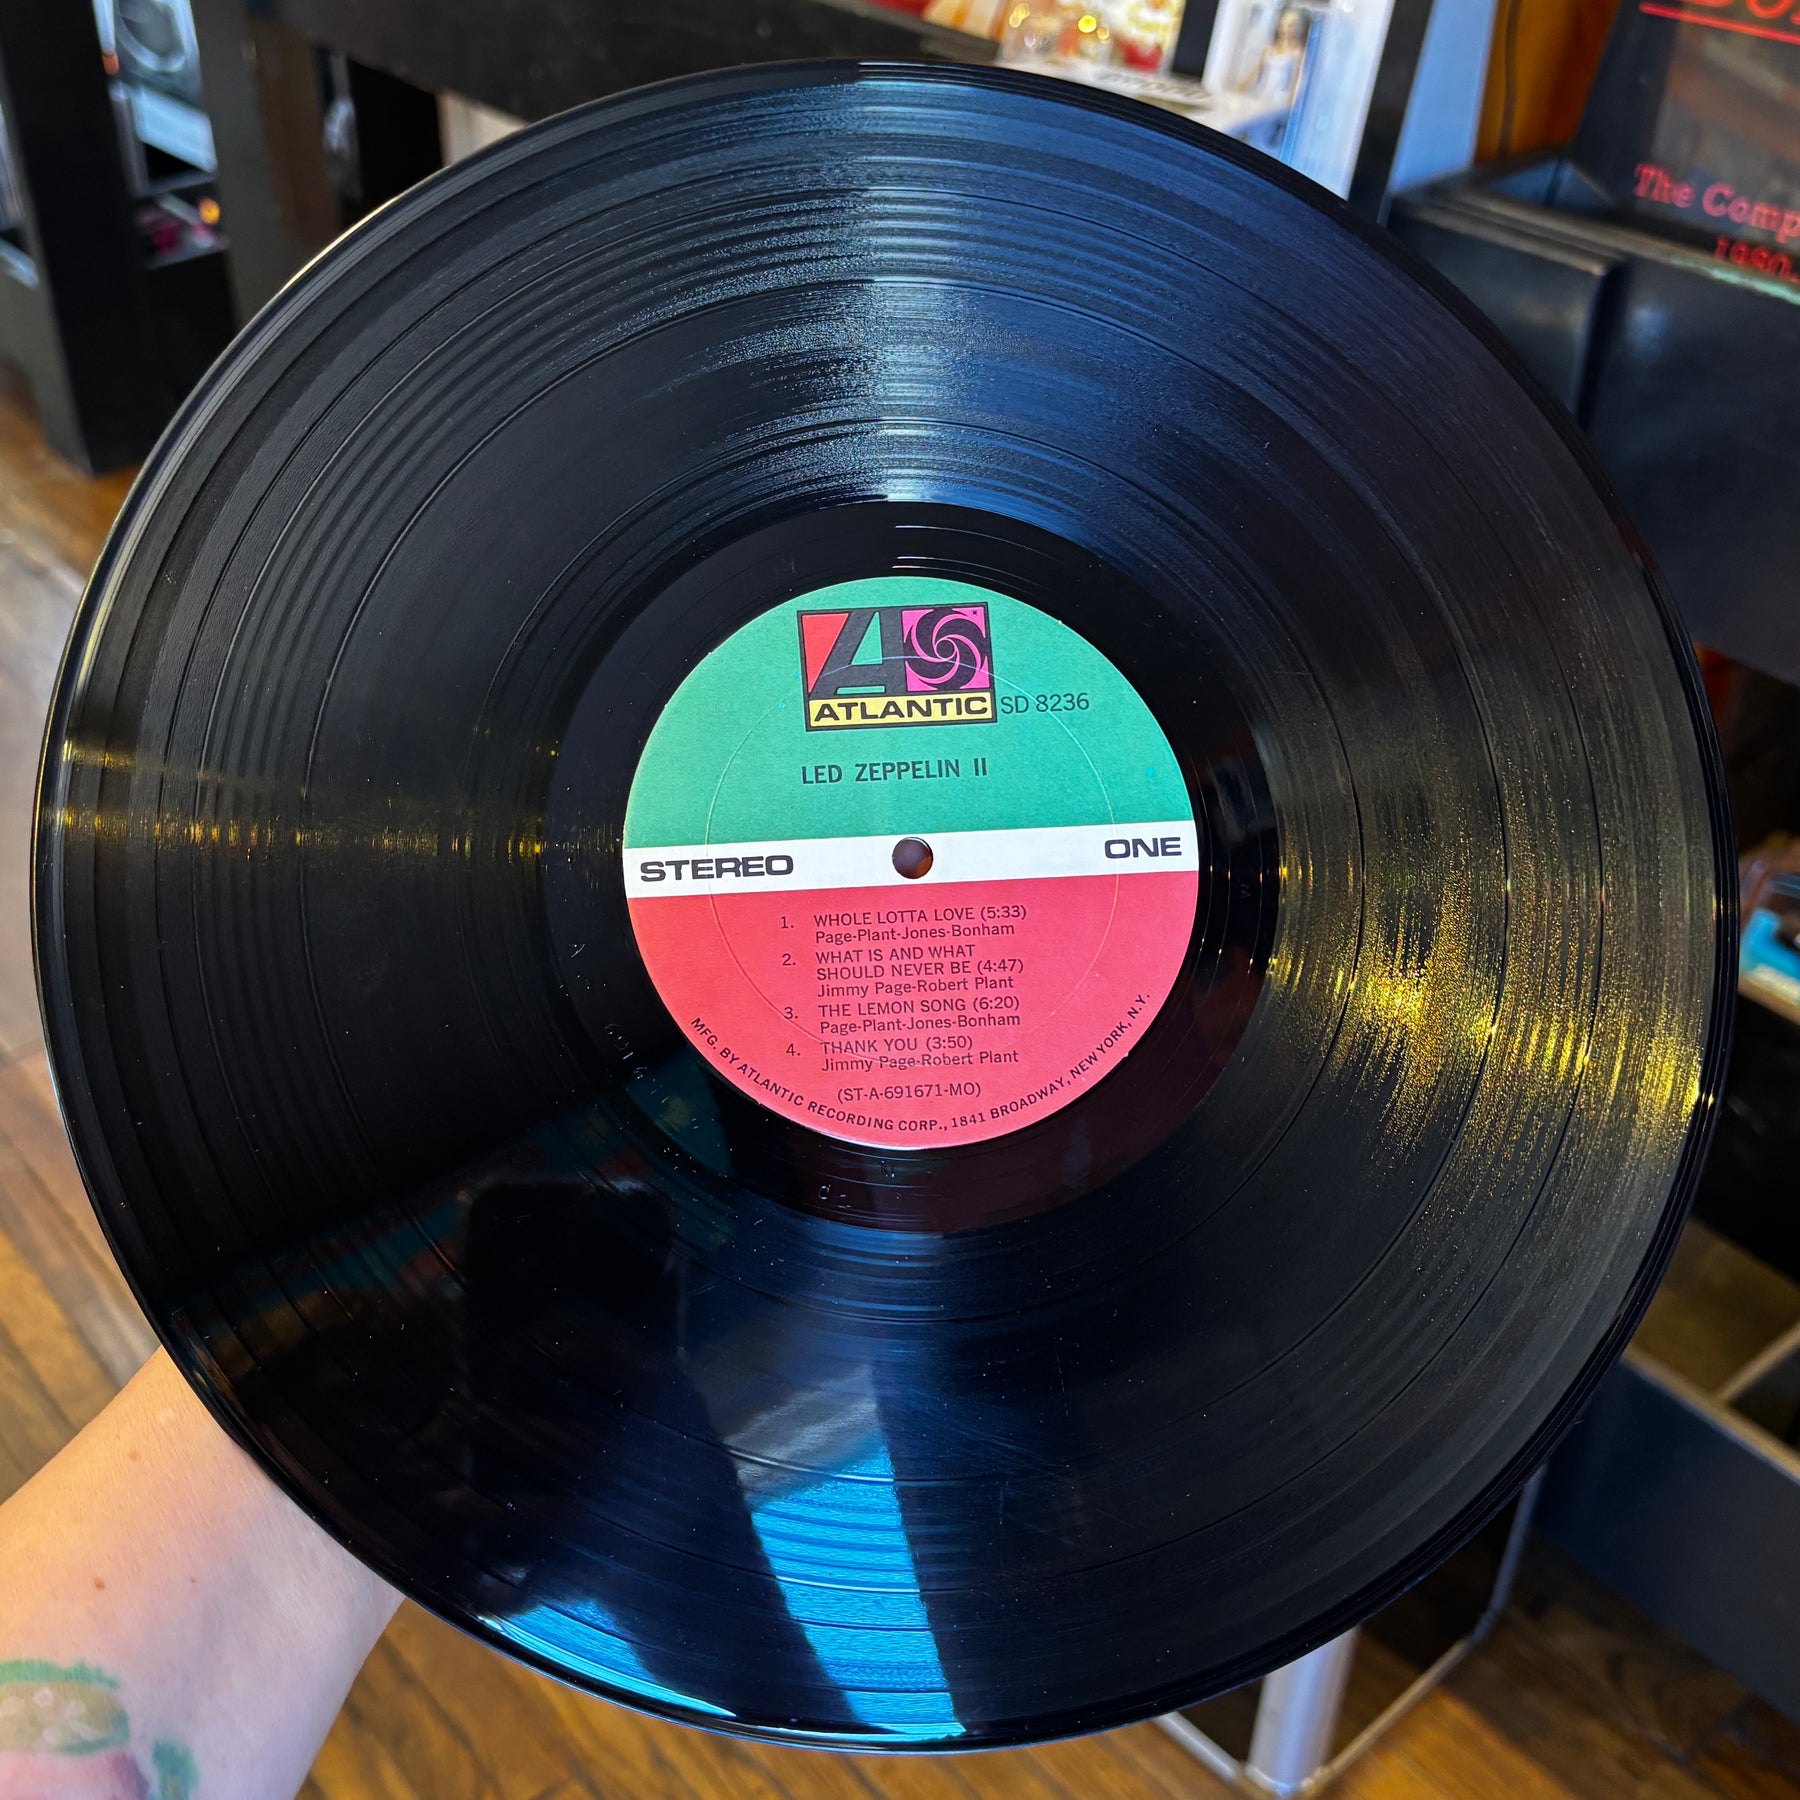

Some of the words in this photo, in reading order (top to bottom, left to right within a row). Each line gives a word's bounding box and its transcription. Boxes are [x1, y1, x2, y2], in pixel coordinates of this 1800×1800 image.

[1635, 163, 1694, 209] The
[814, 696, 988, 722] ATLANTIC
[1001, 697, 1030, 714] SD
[1036, 693, 1090, 712] 8236
[801, 764, 843, 785] LED
[855, 760, 960, 782] ZEPPELIN
[974, 757, 987, 777] II
[1104, 837, 1182, 859] ONE
[640, 854, 794, 882] STEREO
[780, 916, 794, 929] 1.
[813, 912, 872, 927] WHOLE
[877, 909, 928, 924] LOTTA
[934, 907, 975, 922] LOVE
[980, 905, 1027, 921] (5:33)
[815, 923, 1015, 946] Page-Plant-Jones-Bonham
[781, 953, 796, 966] 2.
[815, 949, 863, 964] WHAT
[868, 948, 883, 962] IS
[889, 946, 924, 961] AND
[928, 944, 975, 959] WHAT
[816, 965, 885, 981] SHOULD
[891, 962, 945, 978] NEVER
[950, 960, 972, 975] BE
[977, 958, 1024, 975] (4:47)
[817, 983, 869, 998] Jimmy
[875, 978, 969, 996] Page-Robert
[974, 976, 1015, 990] Plant
[783, 1006, 799, 1020] 3.
[818, 1003, 852, 1018] THE
[857, 1000, 915, 1016] LEMON
[920, 998, 967, 1013] SONG
[973, 996, 1020, 1013] (6:20)
[820, 1013, 1021, 1036] Page-Plant-Jones-Bonham
[785, 1043, 801, 1057] 4.
[820, 1039, 879, 1055] THANK
[883, 1037, 918, 1052] YOU
[926, 1035, 973, 1052] (3:50)
[690, 1017, 719, 1050] MFG.
[719, 1046, 741, 1065] BY
[736, 1063, 805, 1107] ATLANTIC
[807, 1100, 894, 1131] RECORDING
[951, 1112, 986, 1129] 1841
[990, 1076, 1072, 1120] BROADWAY,
[1068, 1051, 1099, 1080] NEW
[1097, 1021, 1133, 1056] YORK,
[1126, 992, 1151, 1022] N.Y.
[821, 1058, 874, 1073] Jimmy
[879, 1052, 974, 1071] Page-Robert
[979, 1050, 1019, 1064] Plant
[837, 1081, 982, 1104] (ST-A-691671-MO)
